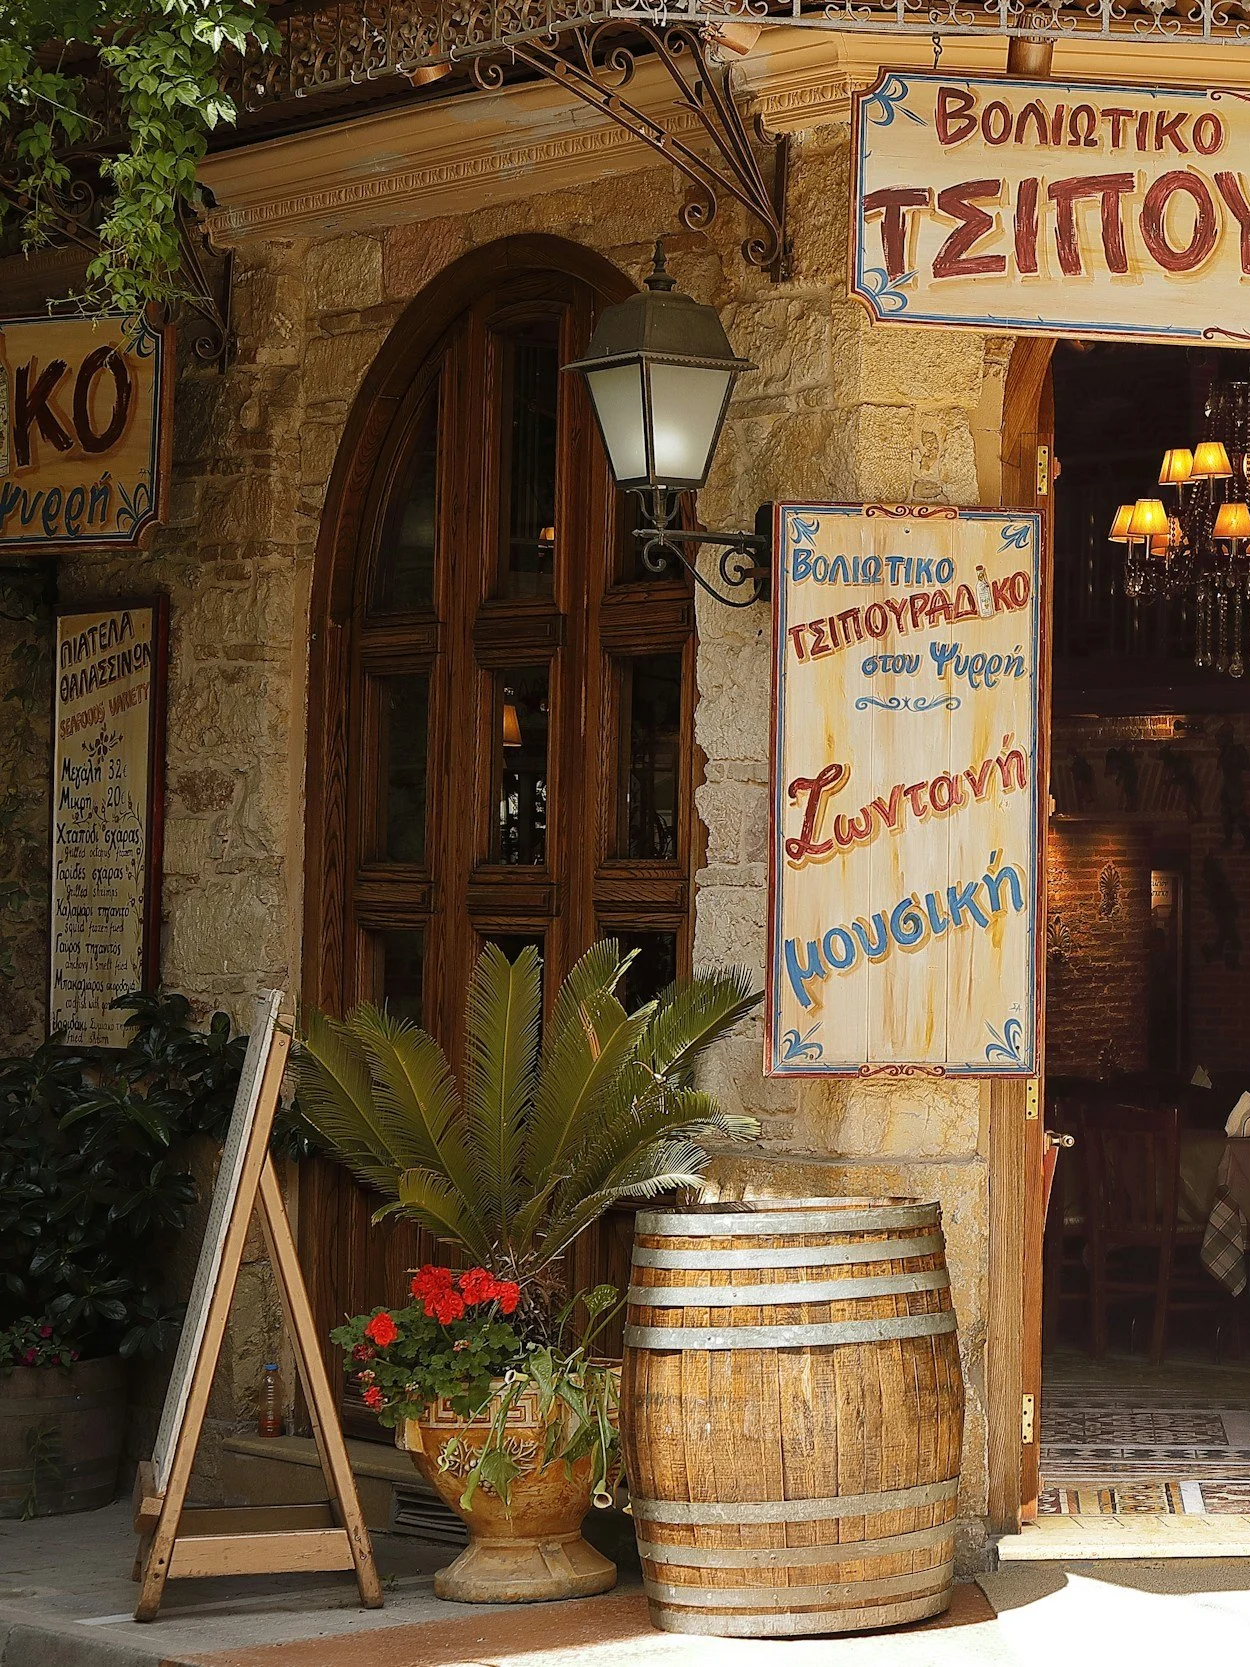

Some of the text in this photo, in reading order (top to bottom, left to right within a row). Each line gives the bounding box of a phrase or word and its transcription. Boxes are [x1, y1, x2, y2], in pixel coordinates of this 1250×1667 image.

[862, 652, 920, 678] στον
[786, 736, 1027, 861] Ζωντανή
[785, 850, 1024, 1008] μουσική
